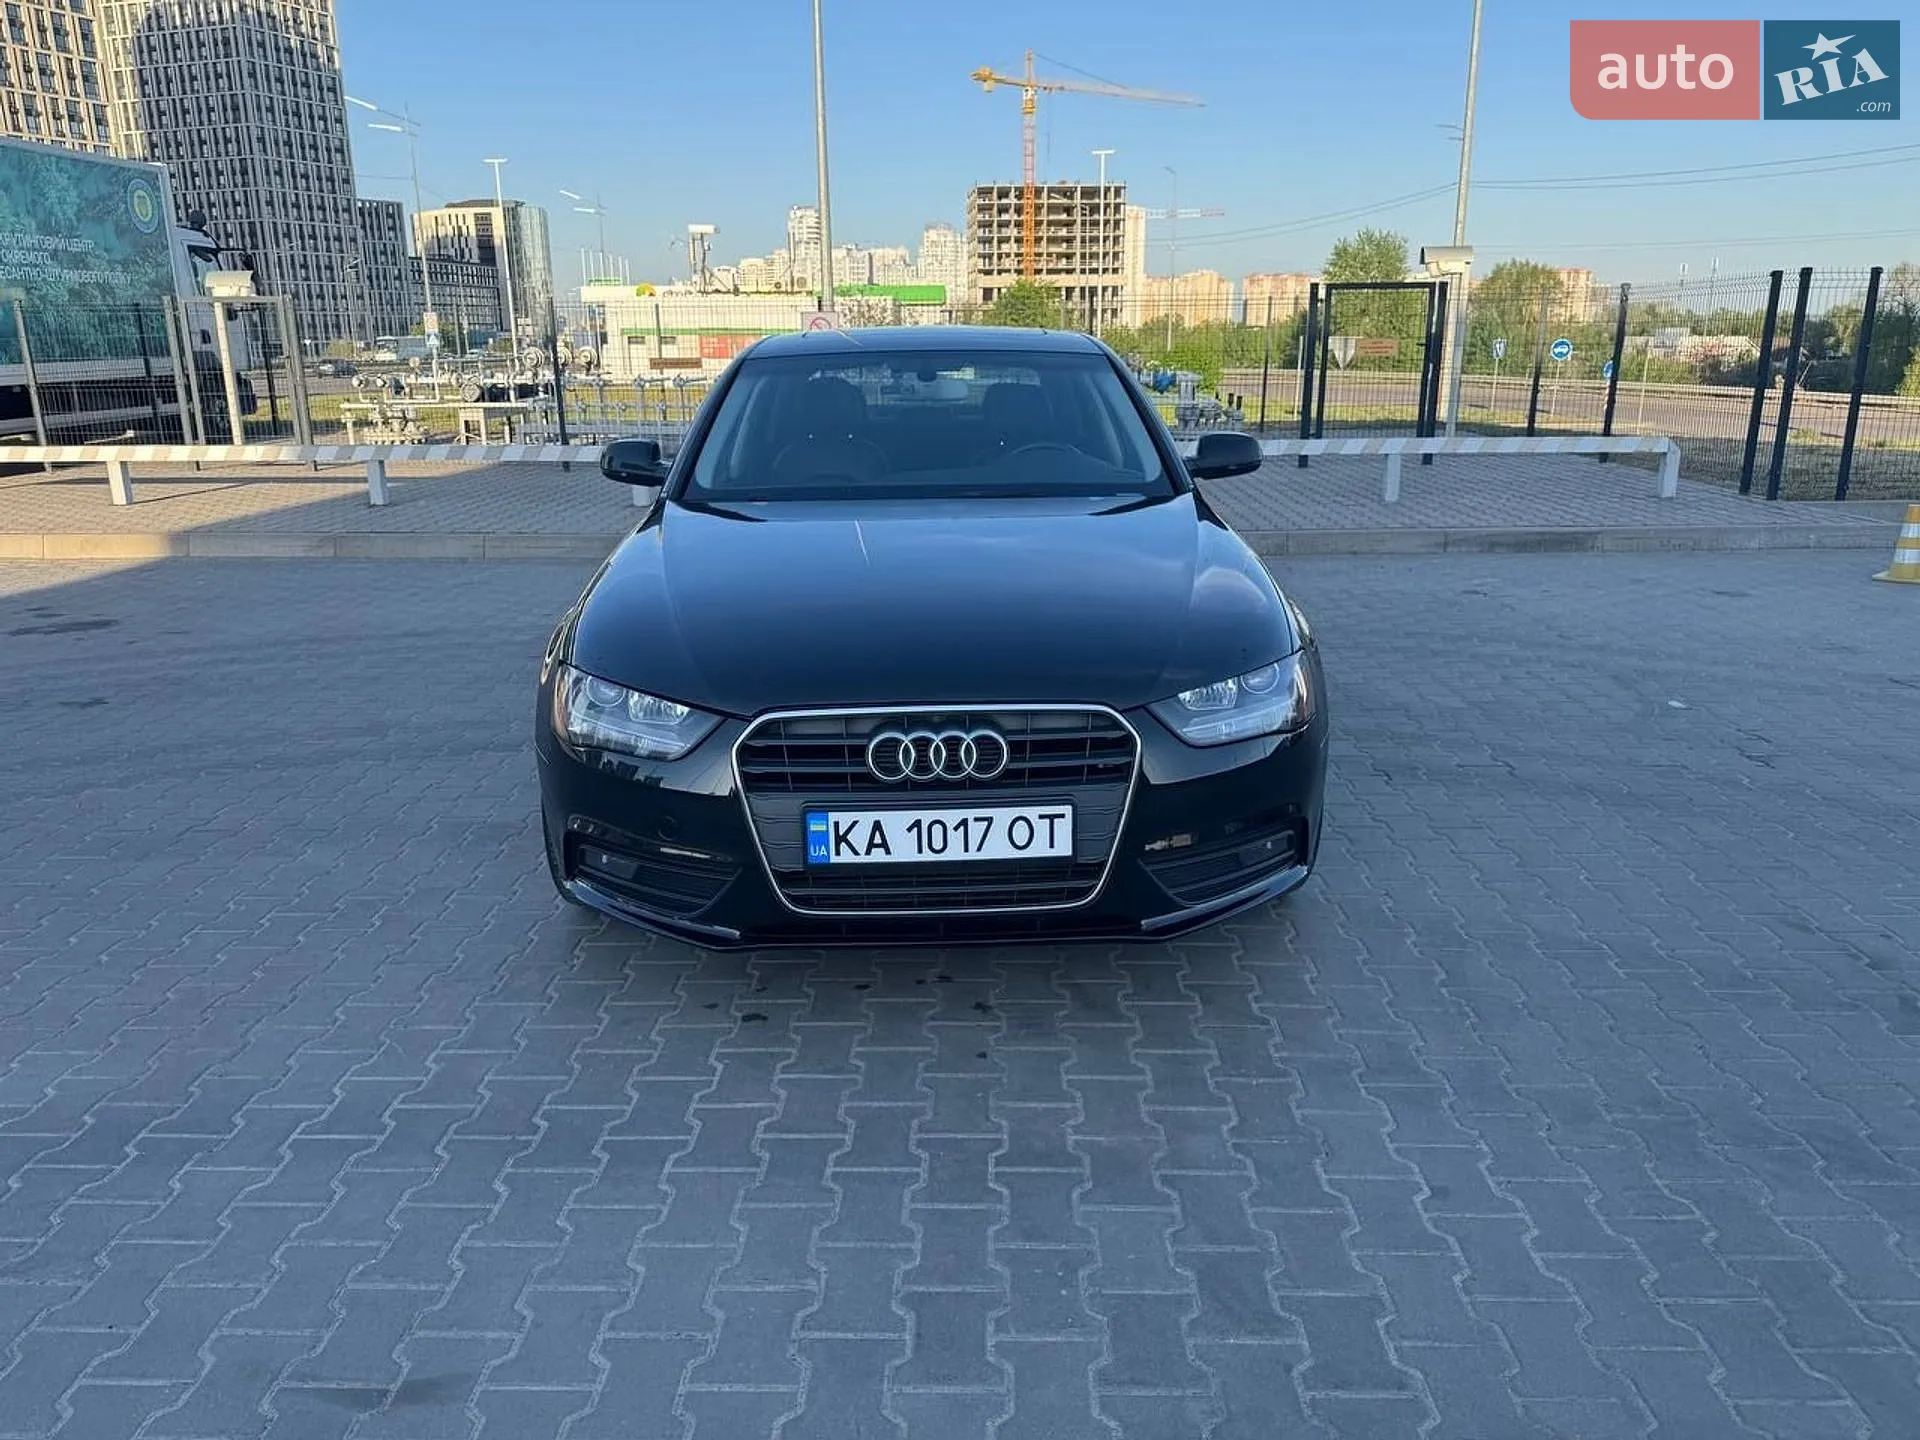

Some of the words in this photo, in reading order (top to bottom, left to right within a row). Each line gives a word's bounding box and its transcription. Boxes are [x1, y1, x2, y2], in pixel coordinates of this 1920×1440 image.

[833, 820, 891, 856] KA
[905, 816, 994, 854] 1017
[1007, 813, 1066, 851] OT
[811, 847, 828, 857] UA
